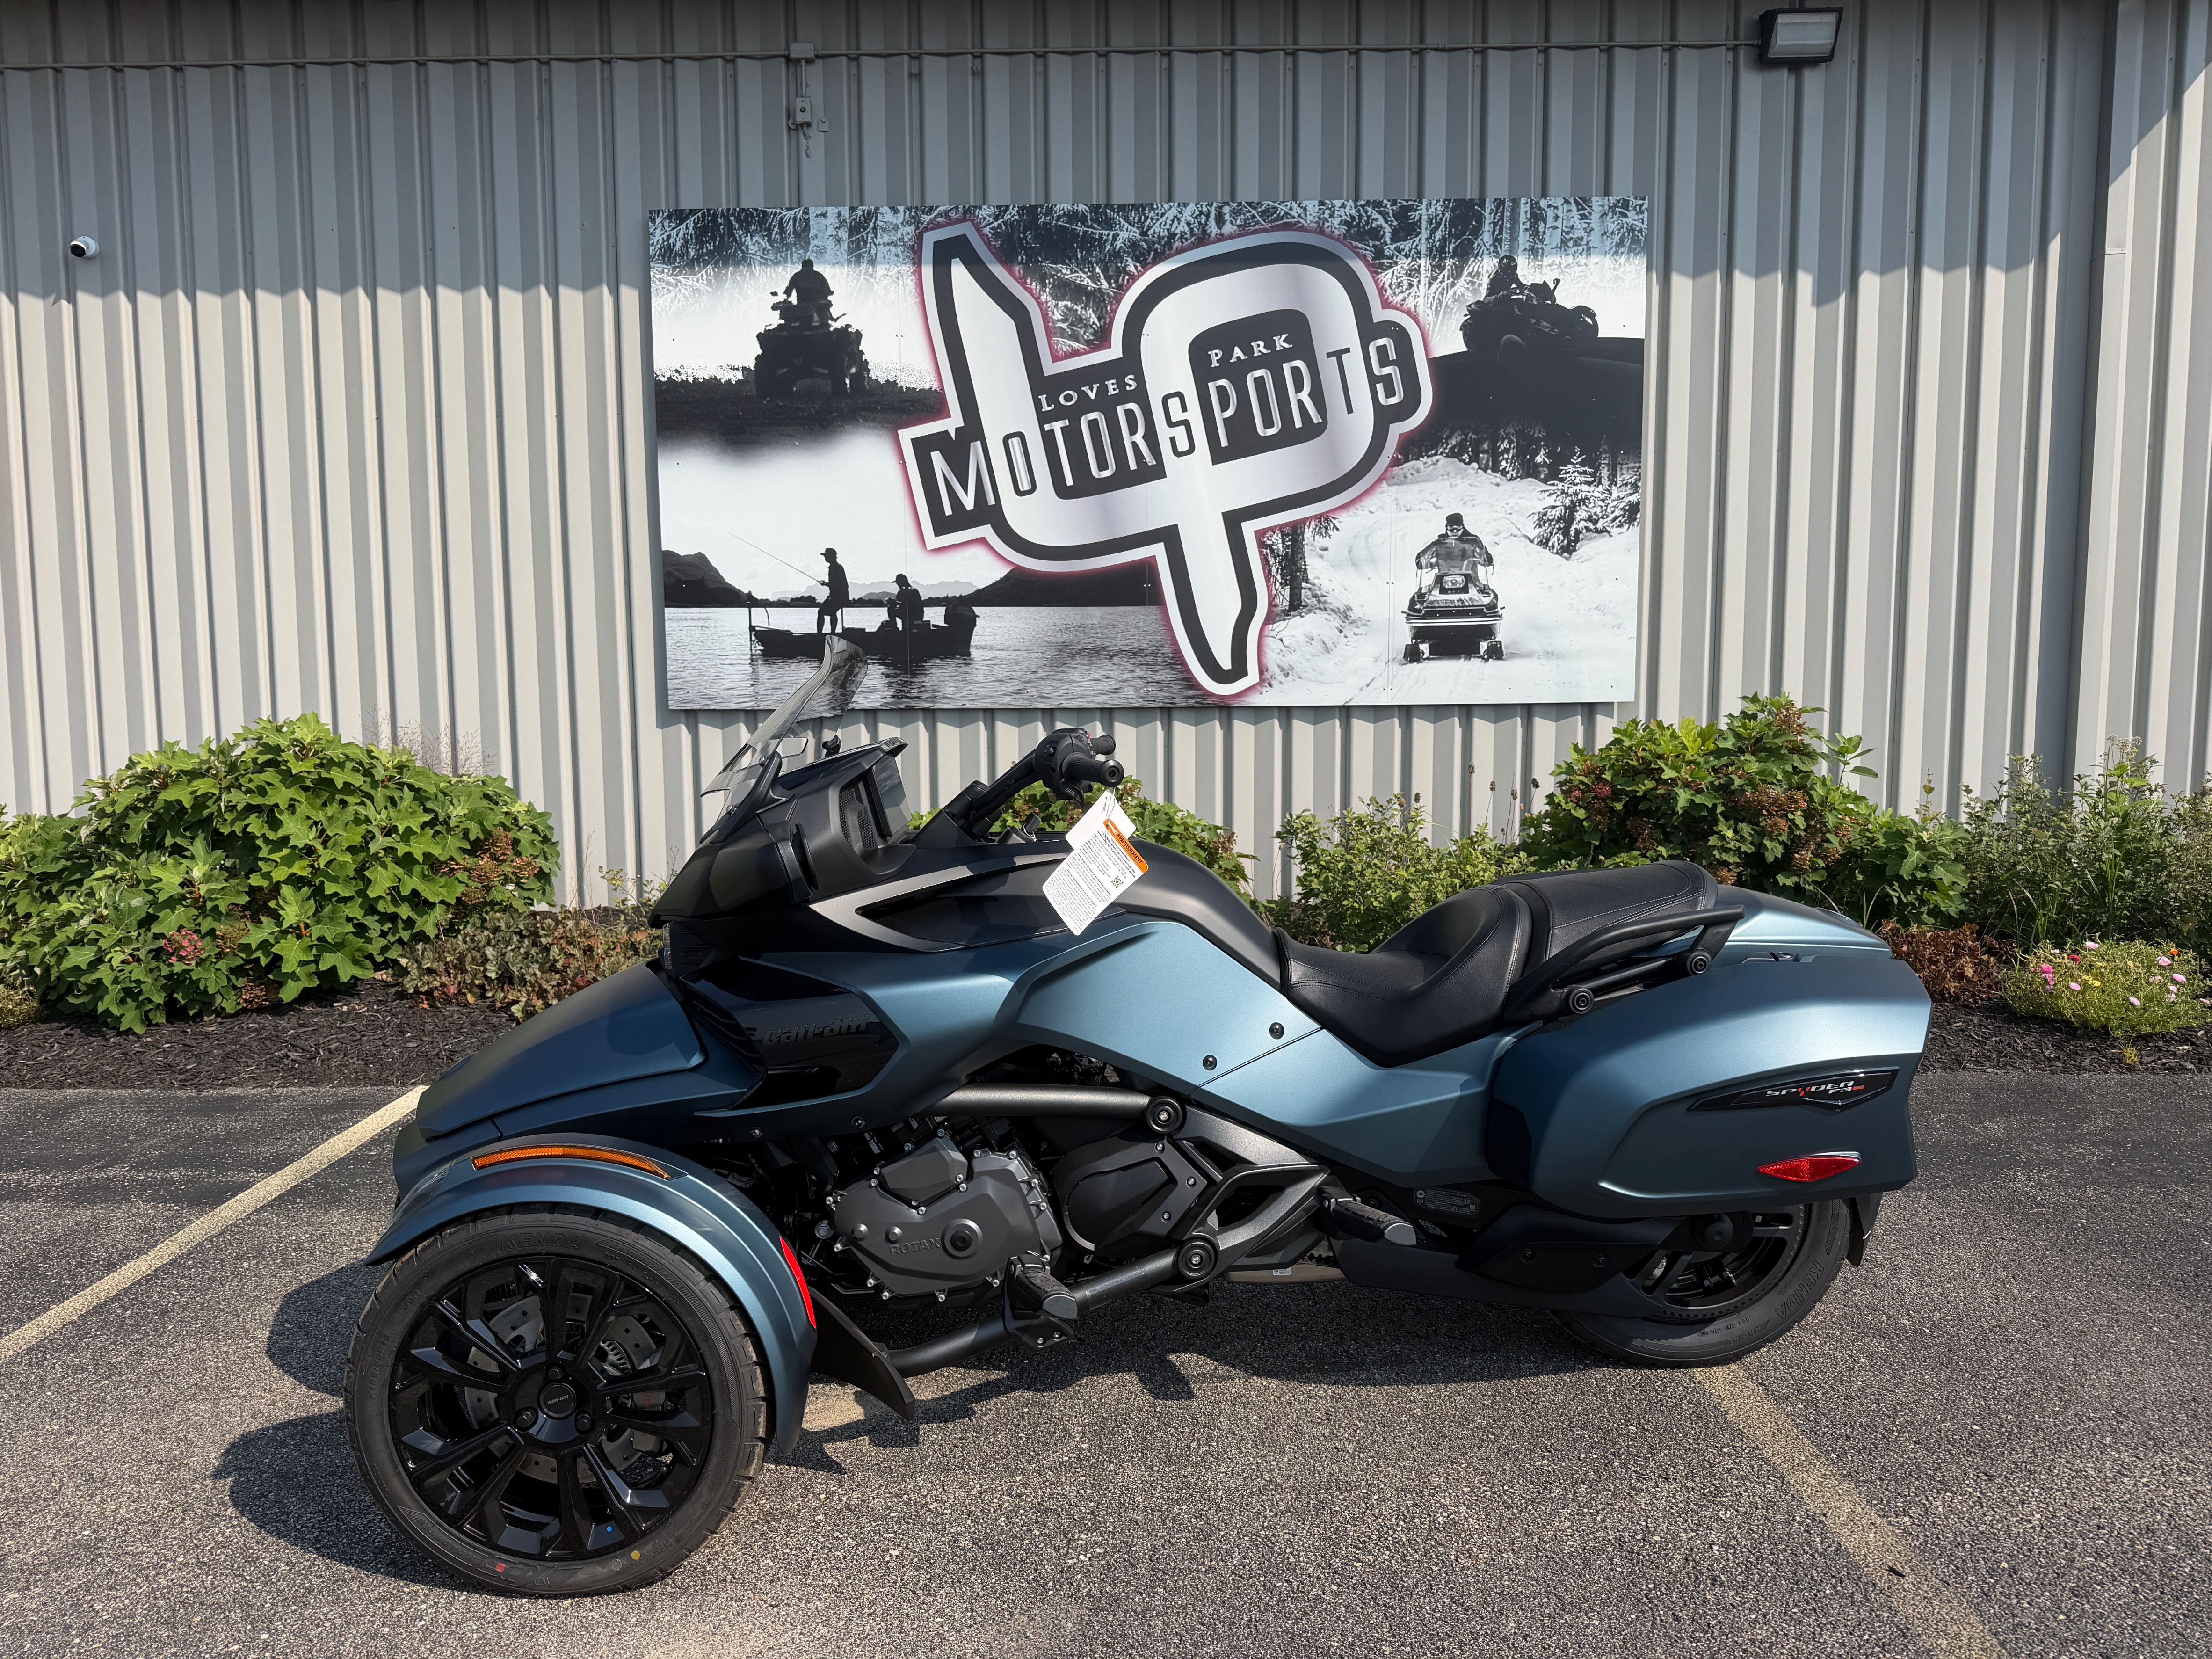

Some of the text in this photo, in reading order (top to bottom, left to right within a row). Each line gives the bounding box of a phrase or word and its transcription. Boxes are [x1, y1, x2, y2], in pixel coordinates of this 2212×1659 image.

[1038, 333, 1293, 412] LOVES PARK
[930, 337, 1404, 517] MOTORSPORTS
[1116, 833, 1143, 864] AVERTISSEMENT
[1766, 1081, 1855, 1096] SPYDER
[500, 1232, 582, 1251] KENDA
[889, 1237, 941, 1256] ROTAX
[1775, 1260, 1825, 1319] KENDA
[547, 1395, 569, 1404] can-am
